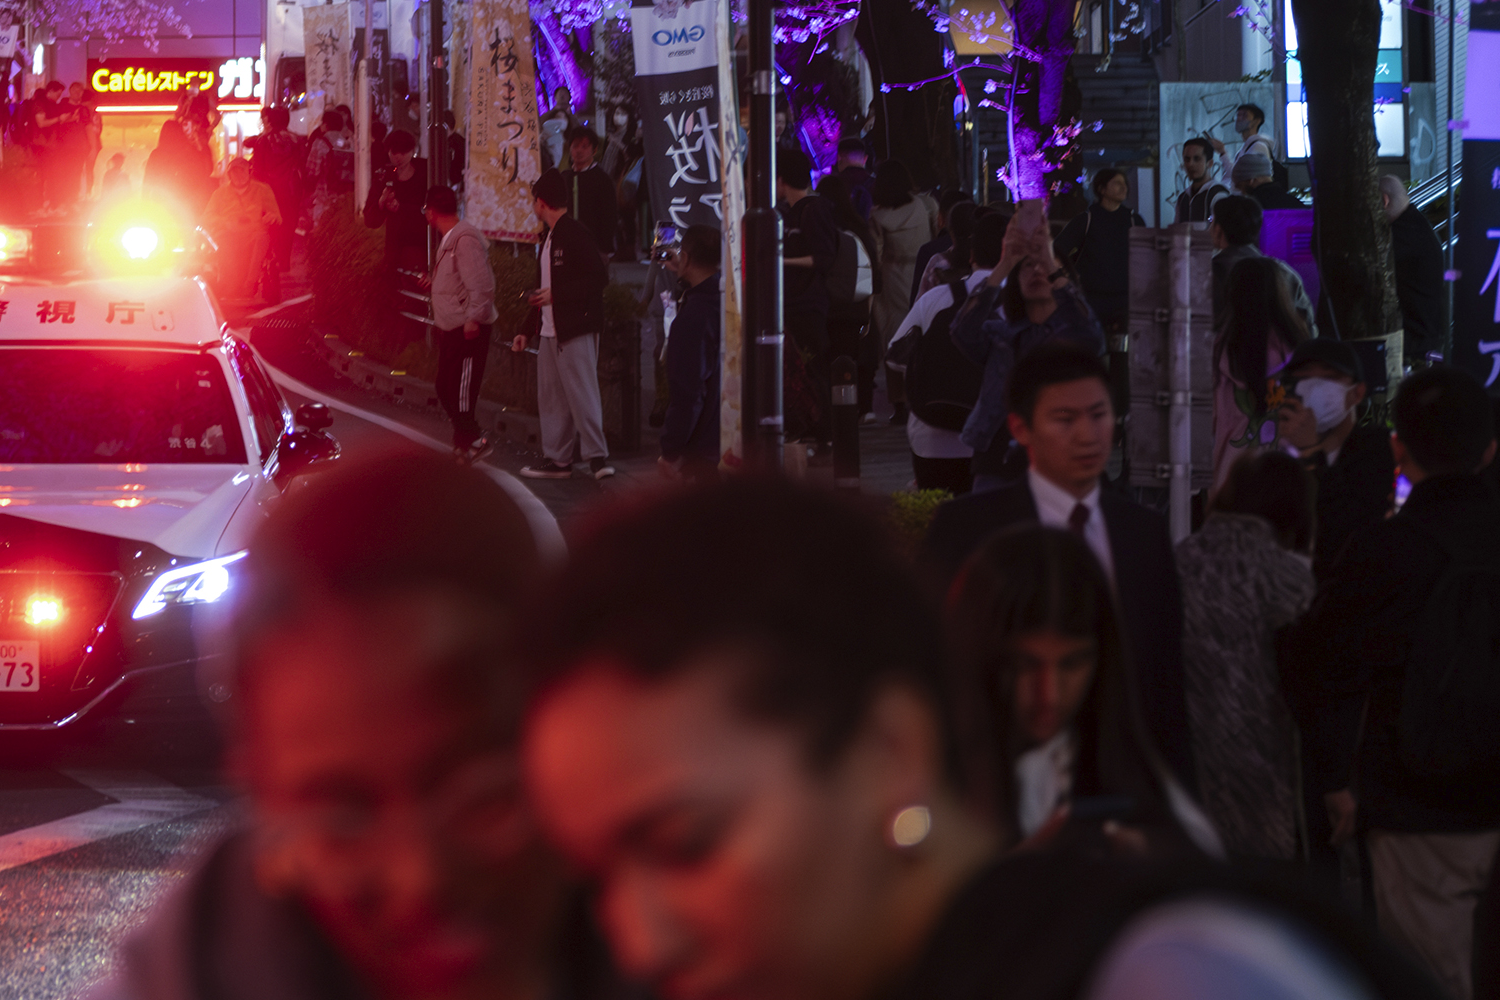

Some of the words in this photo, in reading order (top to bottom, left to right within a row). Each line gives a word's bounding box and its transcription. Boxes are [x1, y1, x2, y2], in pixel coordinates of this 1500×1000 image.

[477, 66, 485, 115] SAKURA
[490, 27, 524, 185] 桜まつり
